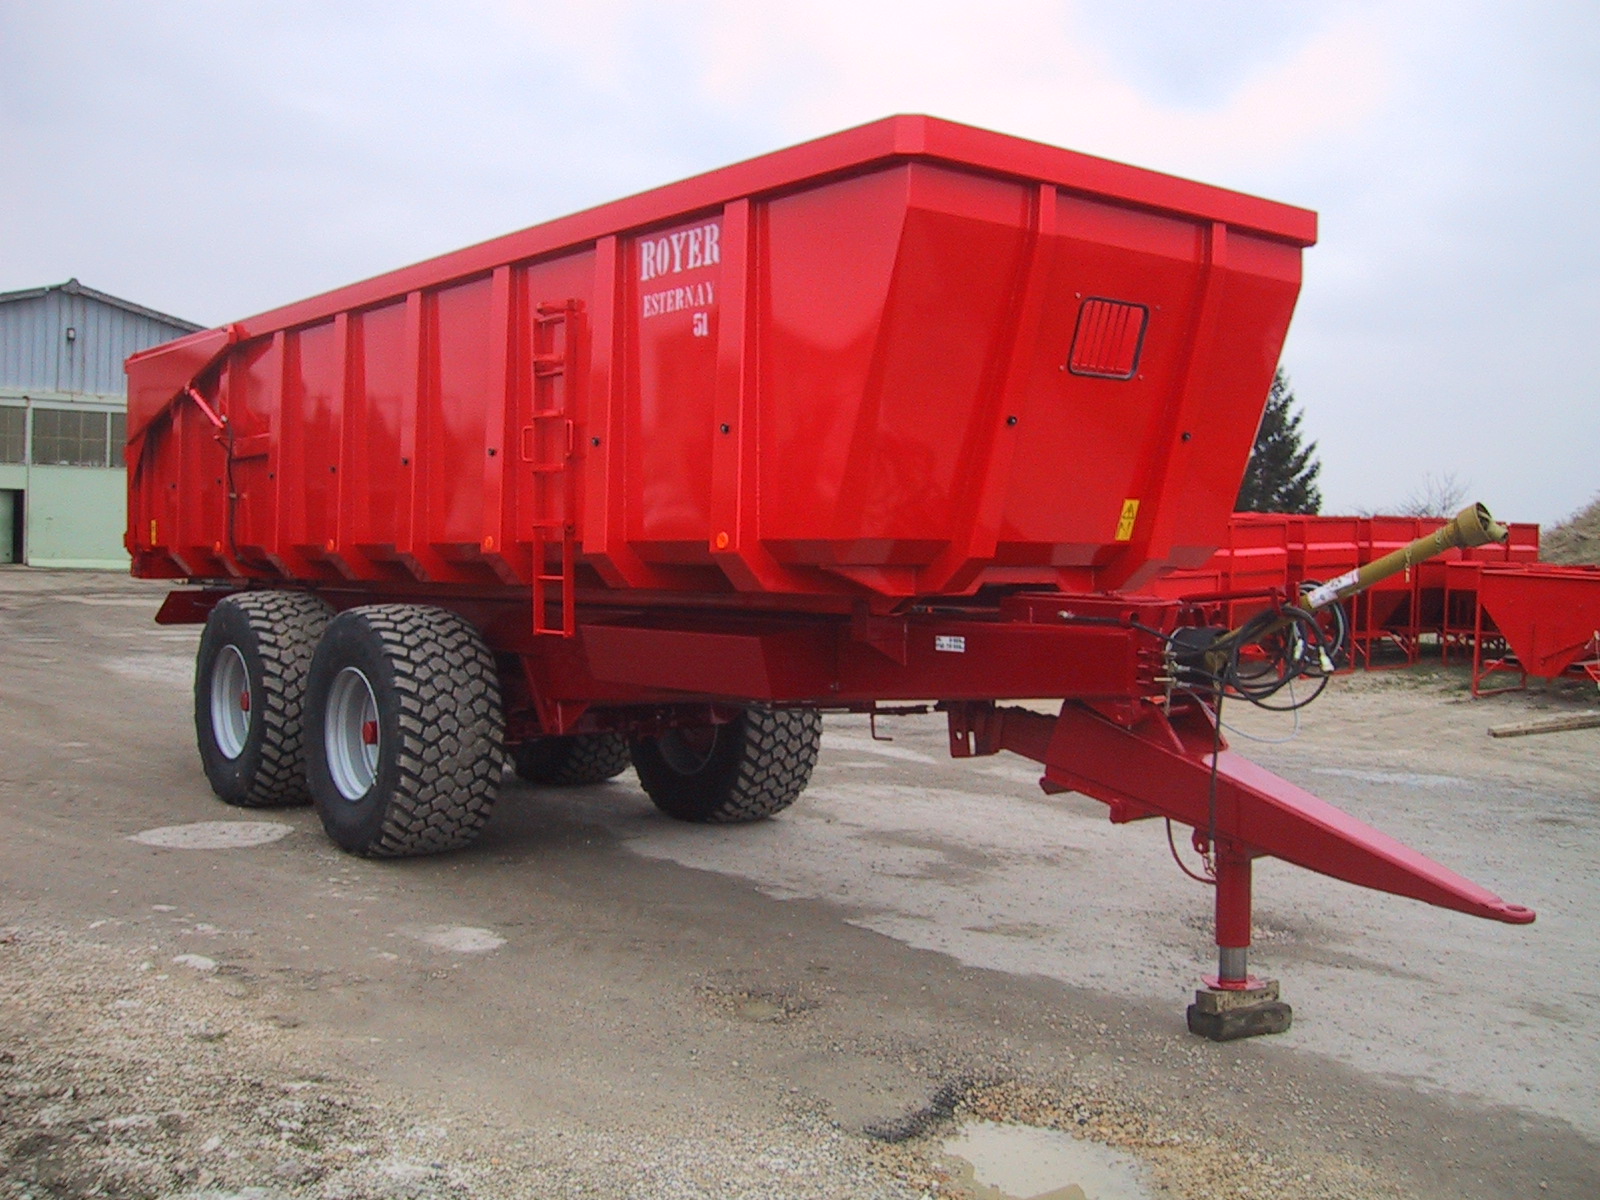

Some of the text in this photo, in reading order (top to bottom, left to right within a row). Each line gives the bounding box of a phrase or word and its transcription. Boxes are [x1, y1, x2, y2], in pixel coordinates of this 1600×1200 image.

[640, 224, 720, 281] ROYER
[643, 281, 715, 318] ESTERNAY
[693, 312, 708, 337] 51
